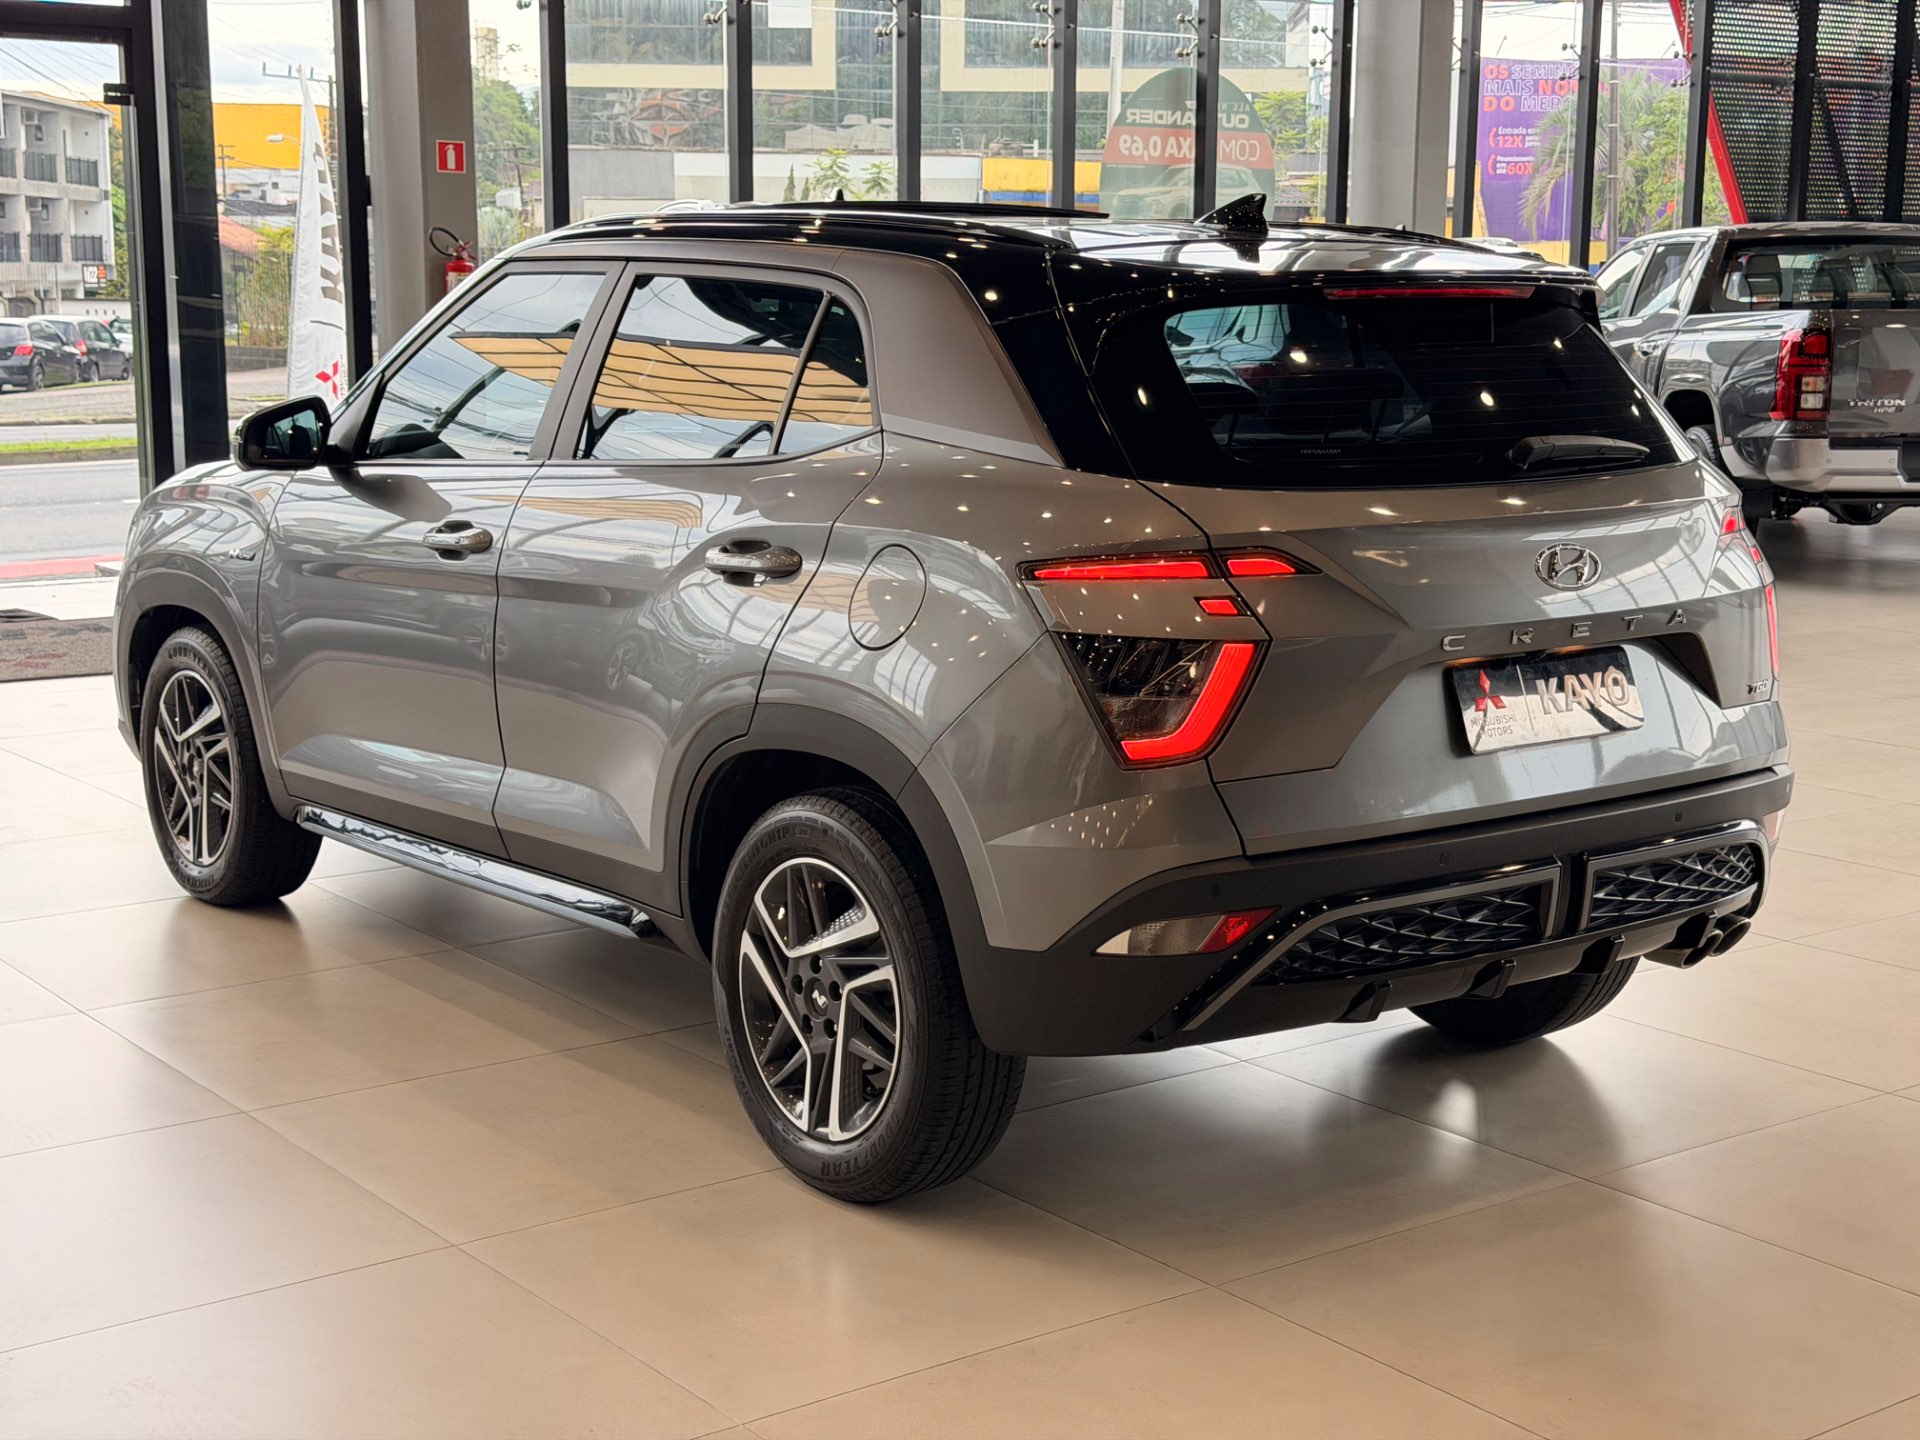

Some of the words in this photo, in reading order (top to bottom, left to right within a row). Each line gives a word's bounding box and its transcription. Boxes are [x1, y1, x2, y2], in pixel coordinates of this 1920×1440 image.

[1484, 64, 1509, 80] OS
[1483, 80, 1534, 96] MAIS
[1483, 96, 1516, 112] DO
[1497, 135, 1523, 149] 12X
[1441, 608, 1688, 652] CRETA
